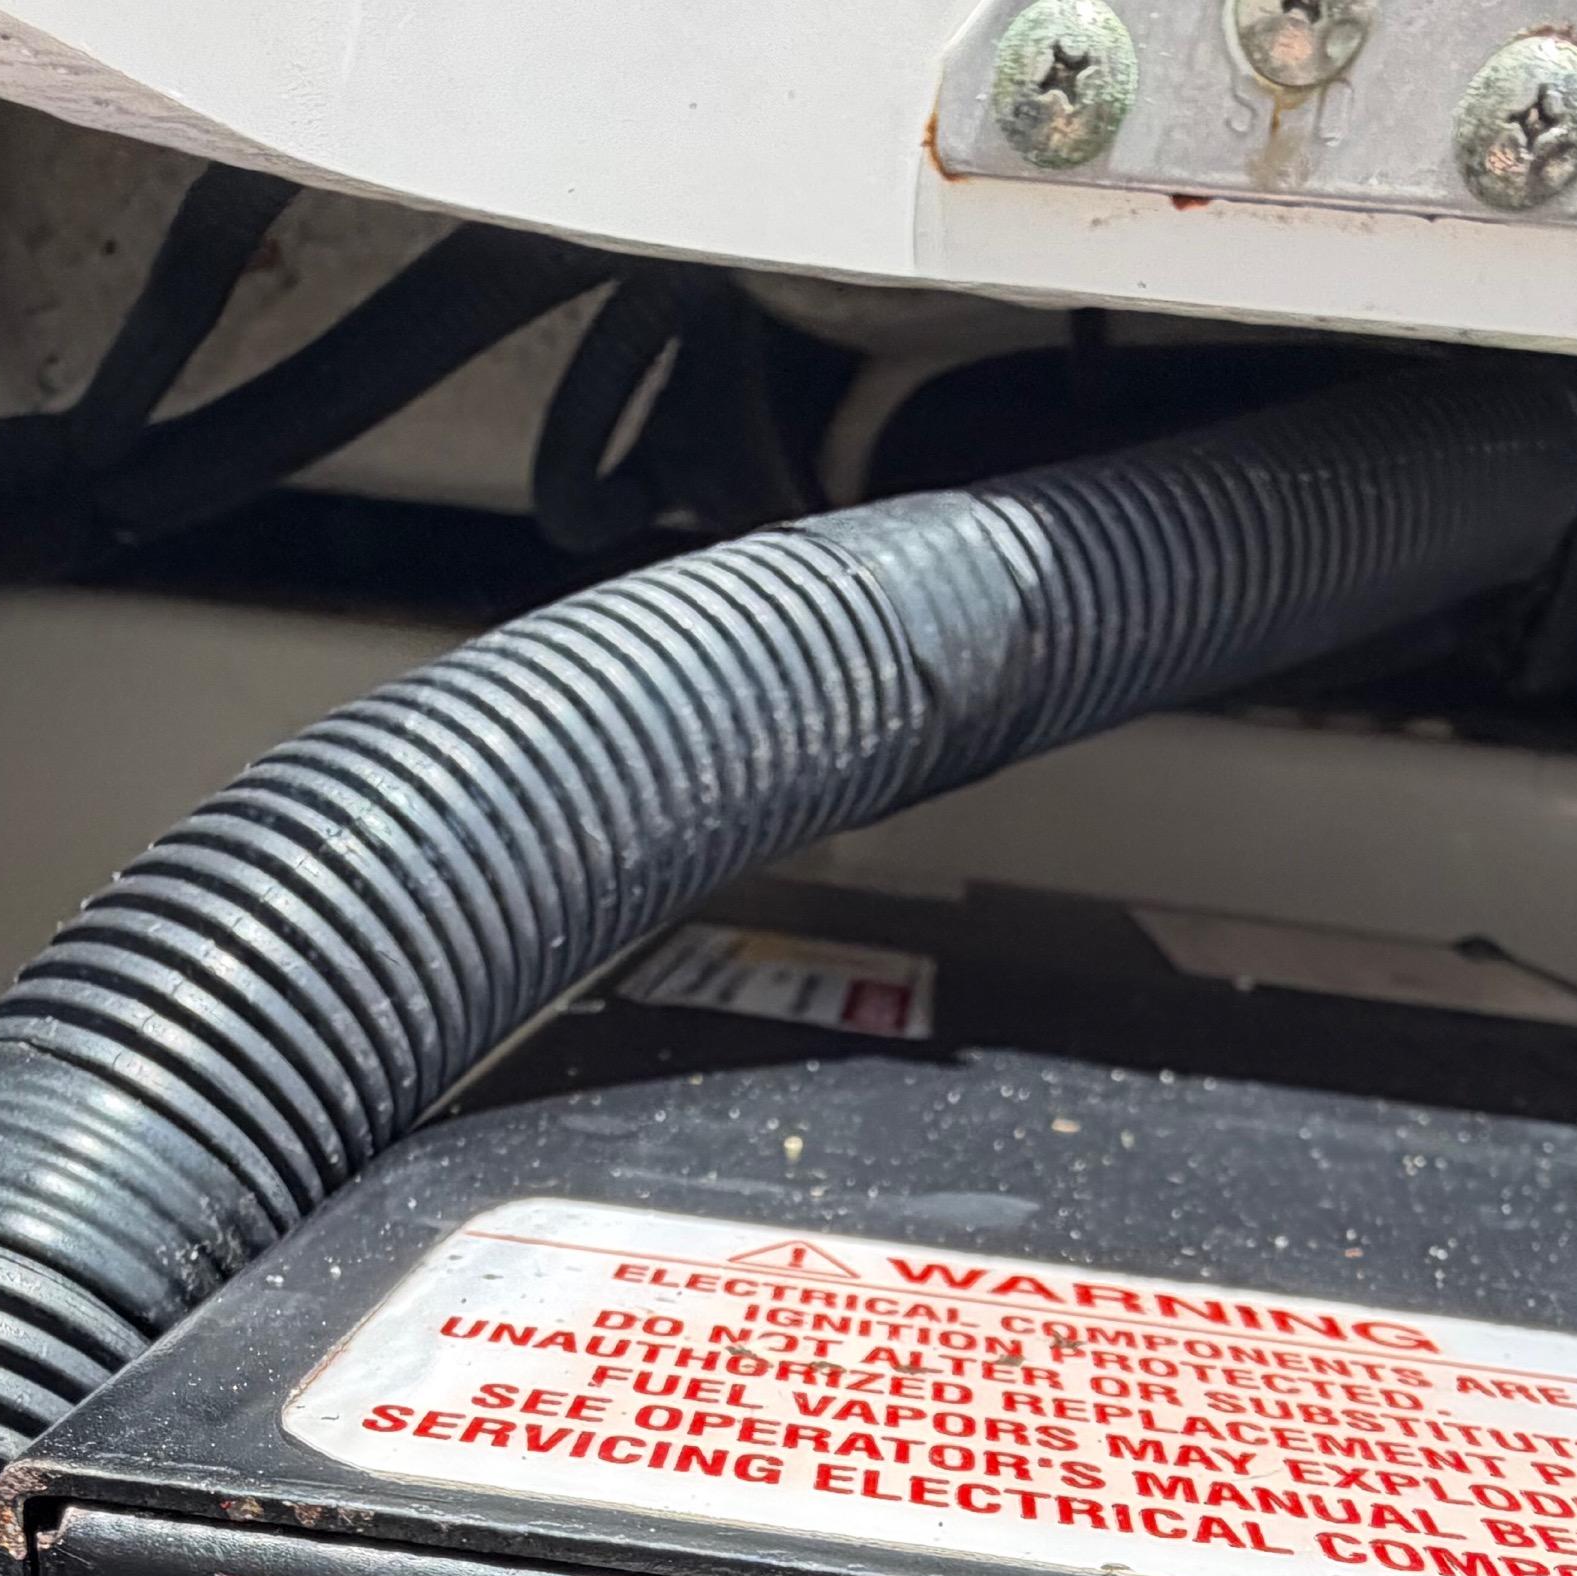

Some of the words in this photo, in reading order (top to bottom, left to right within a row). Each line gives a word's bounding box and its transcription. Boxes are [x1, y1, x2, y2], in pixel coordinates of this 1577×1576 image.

[592, 1309, 684, 1337] DO
[708, 1325, 843, 1358] NOT
[861, 1345, 1064, 1391] ALTER
[1090, 1374, 1181, 1406] OR
[613, 1263, 979, 1328] ELECTRICAL
[1000, 1315, 1433, 1388] COMPONENTS
[744, 1304, 1023, 1358] IGNITION
[1049, 1346, 1452, 1417] PROTECTED.
[888, 1257, 1440, 1354] WARNING
[439, 1315, 975, 1406] UNAUTHORIZED
[1001, 1389, 1506, 1478] REPLACEMENT
[588, 1365, 764, 1410] FUEL
[792, 1391, 1080, 1452] VAPORS
[1105, 1432, 1257, 1476] MAY
[361, 1403, 784, 1485] SERVICING
[814, 1462, 1295, 1556] ELECTRICAL
[470, 1383, 613, 1423] SEE
[634, 1404, 1107, 1490] OPERATOR'S
[1131, 1468, 1467, 1541] MANUAL
